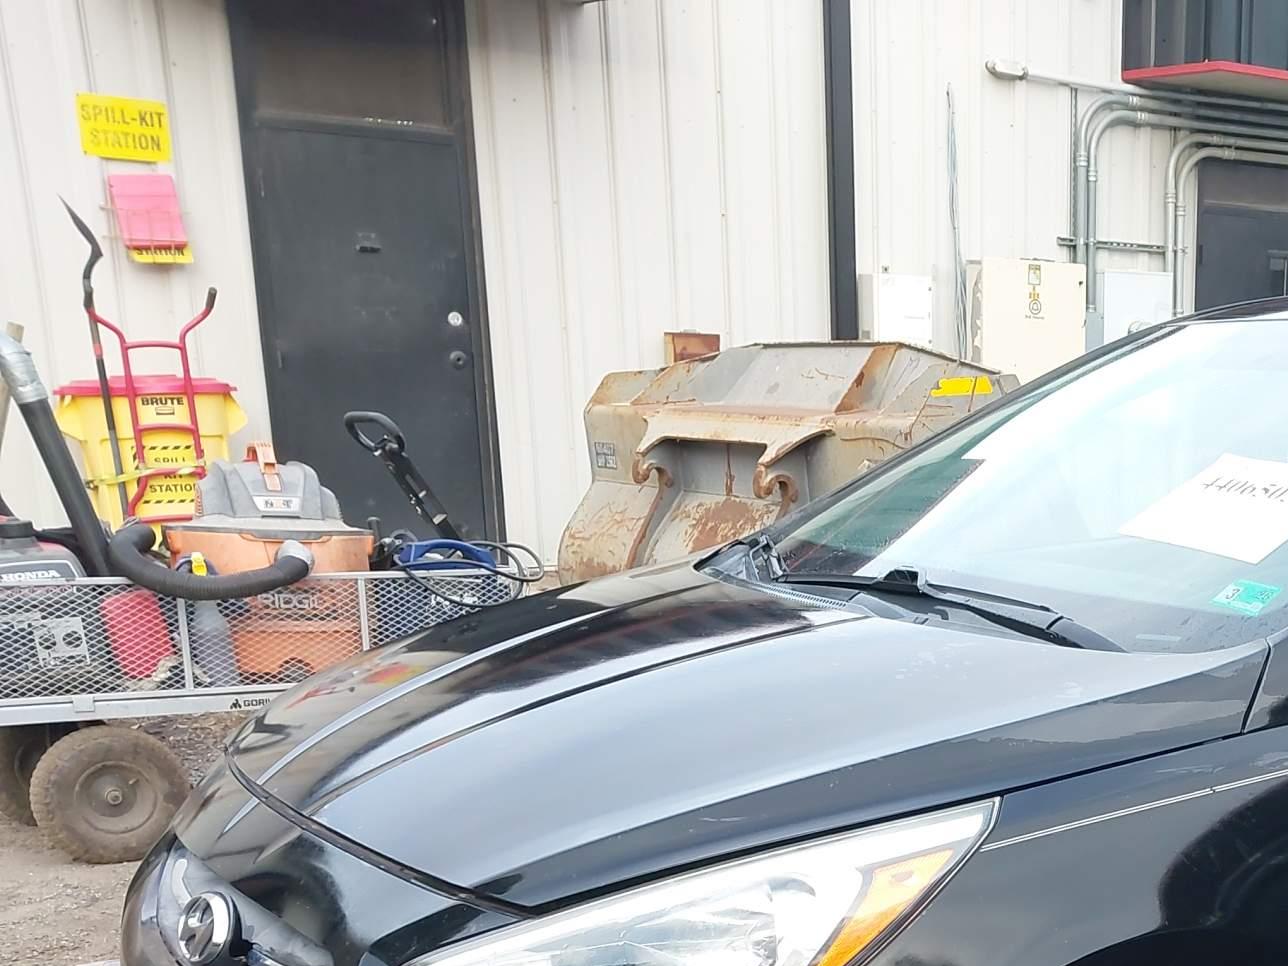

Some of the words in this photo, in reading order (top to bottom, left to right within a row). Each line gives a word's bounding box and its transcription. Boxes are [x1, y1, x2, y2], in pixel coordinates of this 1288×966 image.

[80, 104, 164, 129] SPILL-KIT
[90, 128, 161, 152] STATION
[141, 396, 184, 406] BRUTE
[149, 483, 196, 493] STATIO
[1, 569, 61, 581] HONDA
[257, 593, 319, 608] RIDGI
